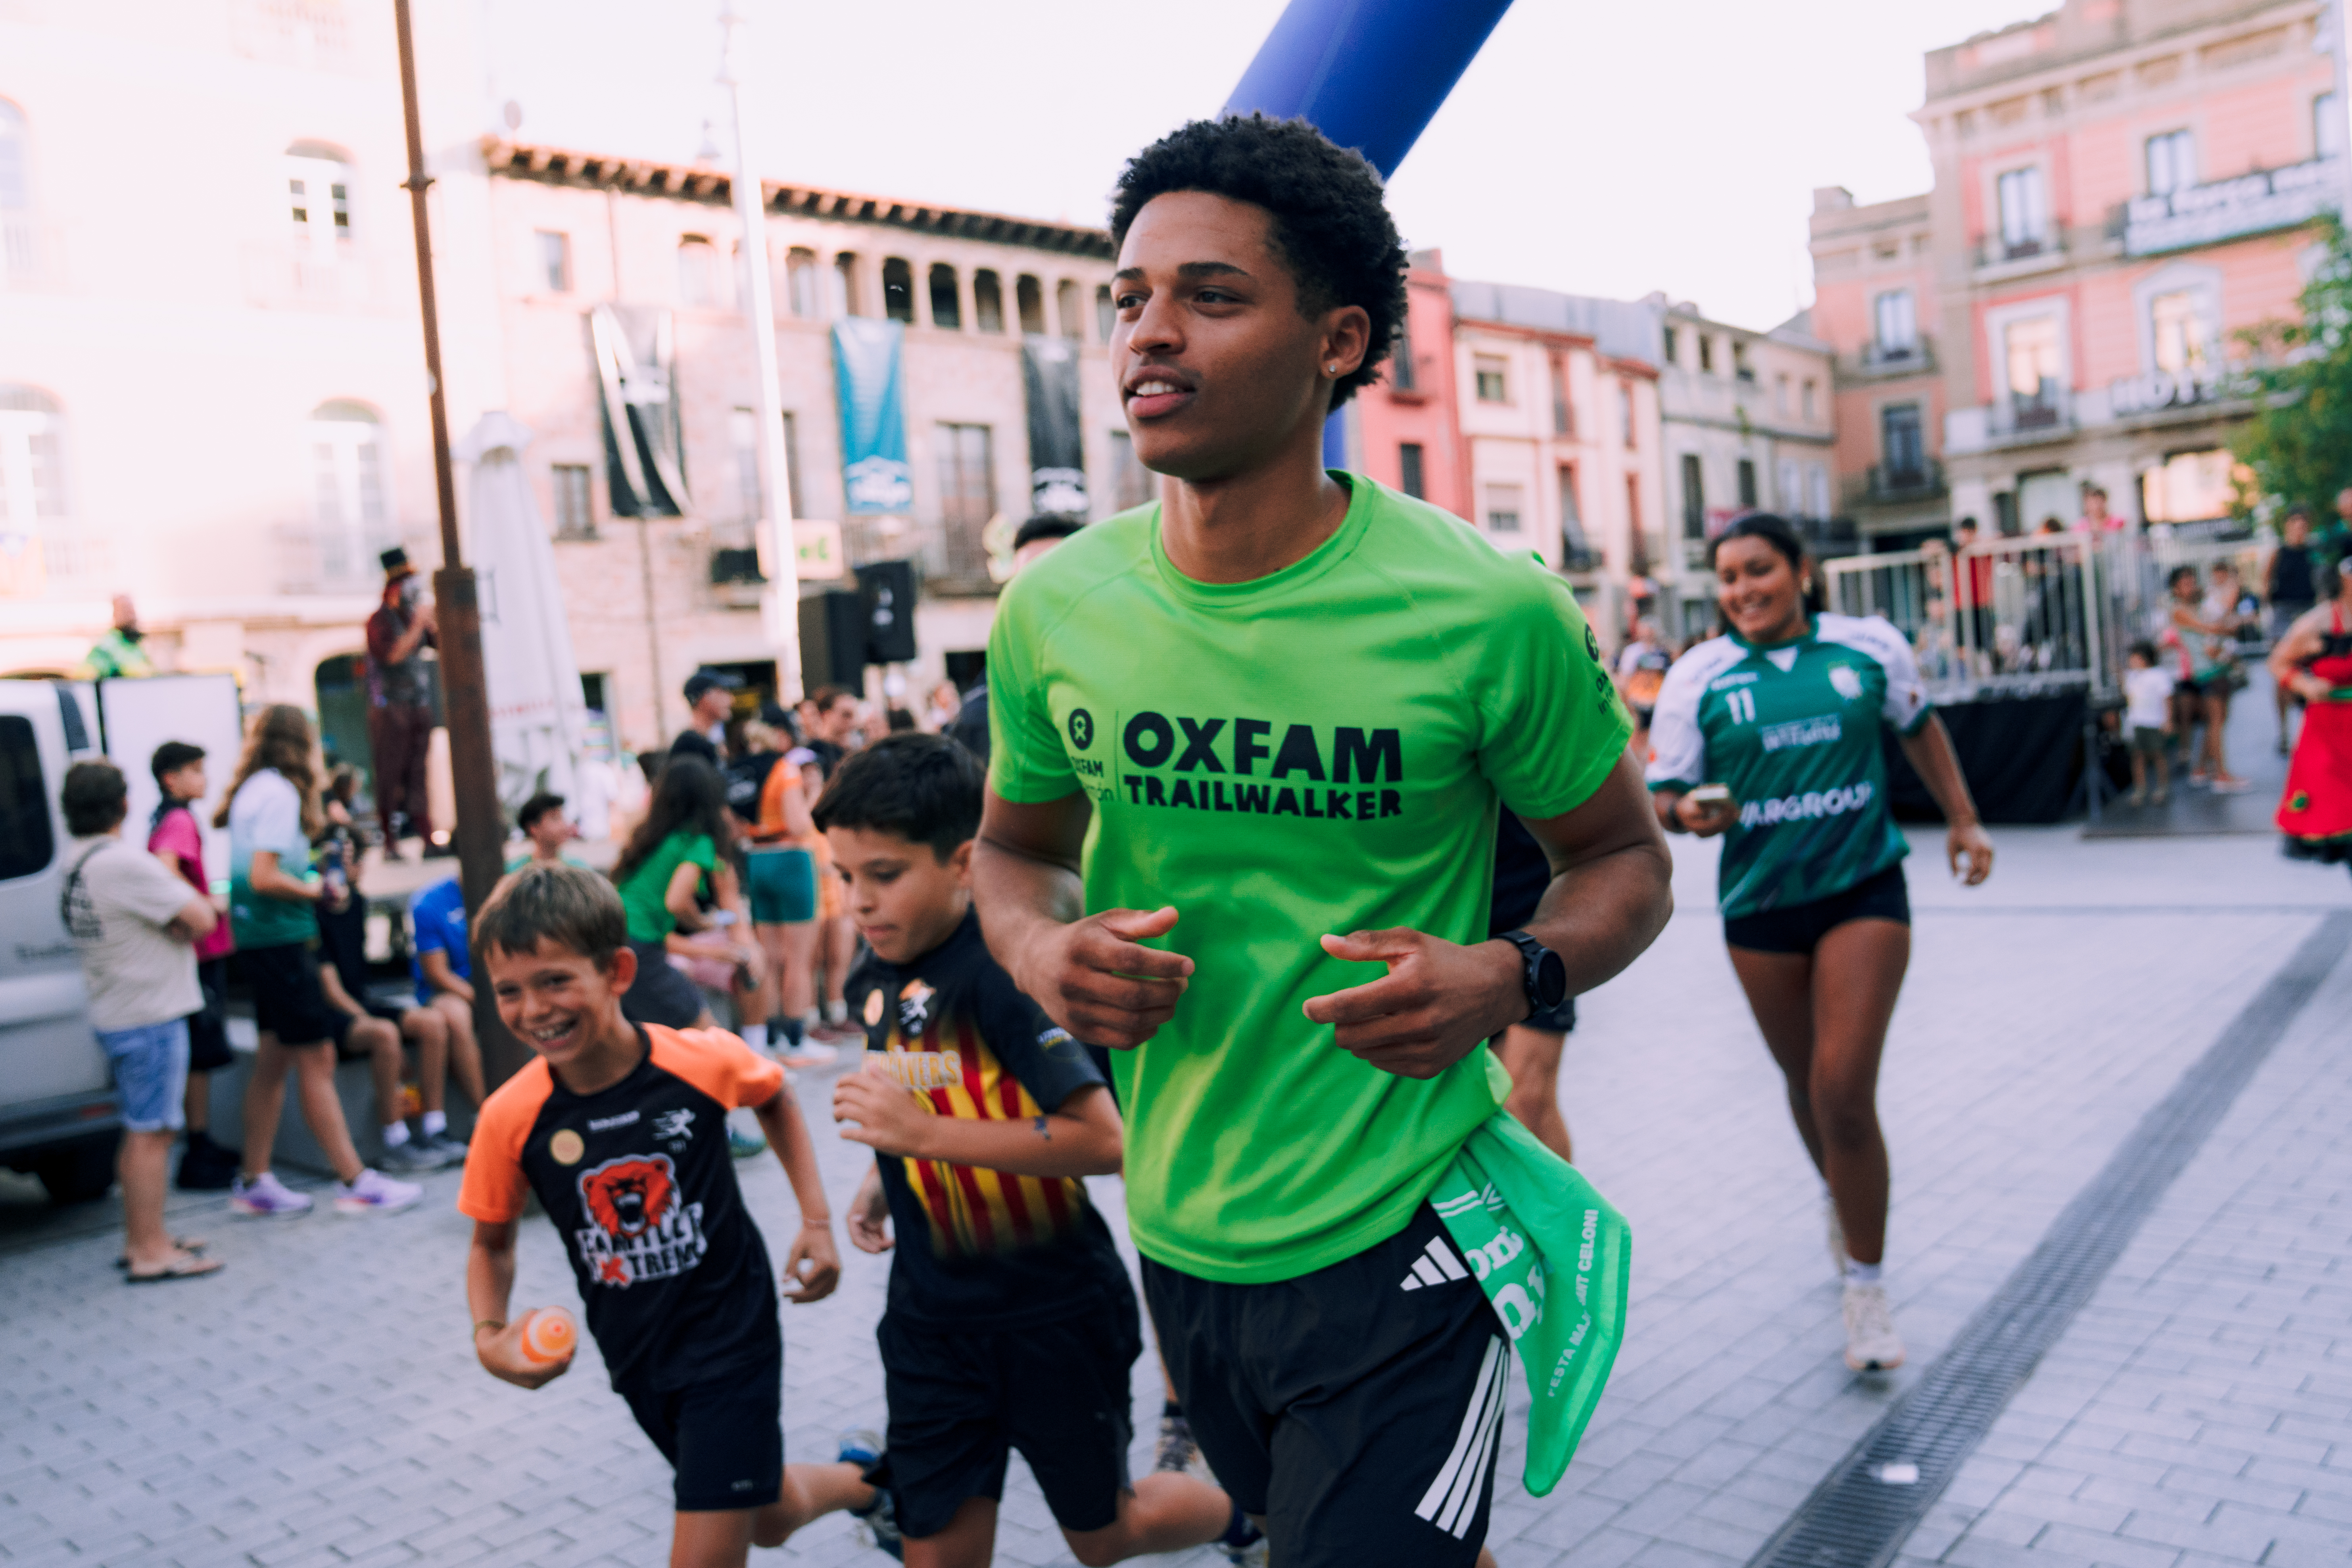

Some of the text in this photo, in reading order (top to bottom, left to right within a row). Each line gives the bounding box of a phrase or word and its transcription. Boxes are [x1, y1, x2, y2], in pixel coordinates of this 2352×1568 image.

[1725, 688, 1756, 724] 11
[1123, 711, 1404, 784] OXFAM
[1123, 775, 1403, 821] TRAILWALKER
[1577, 1209, 1599, 1272] CELONI
